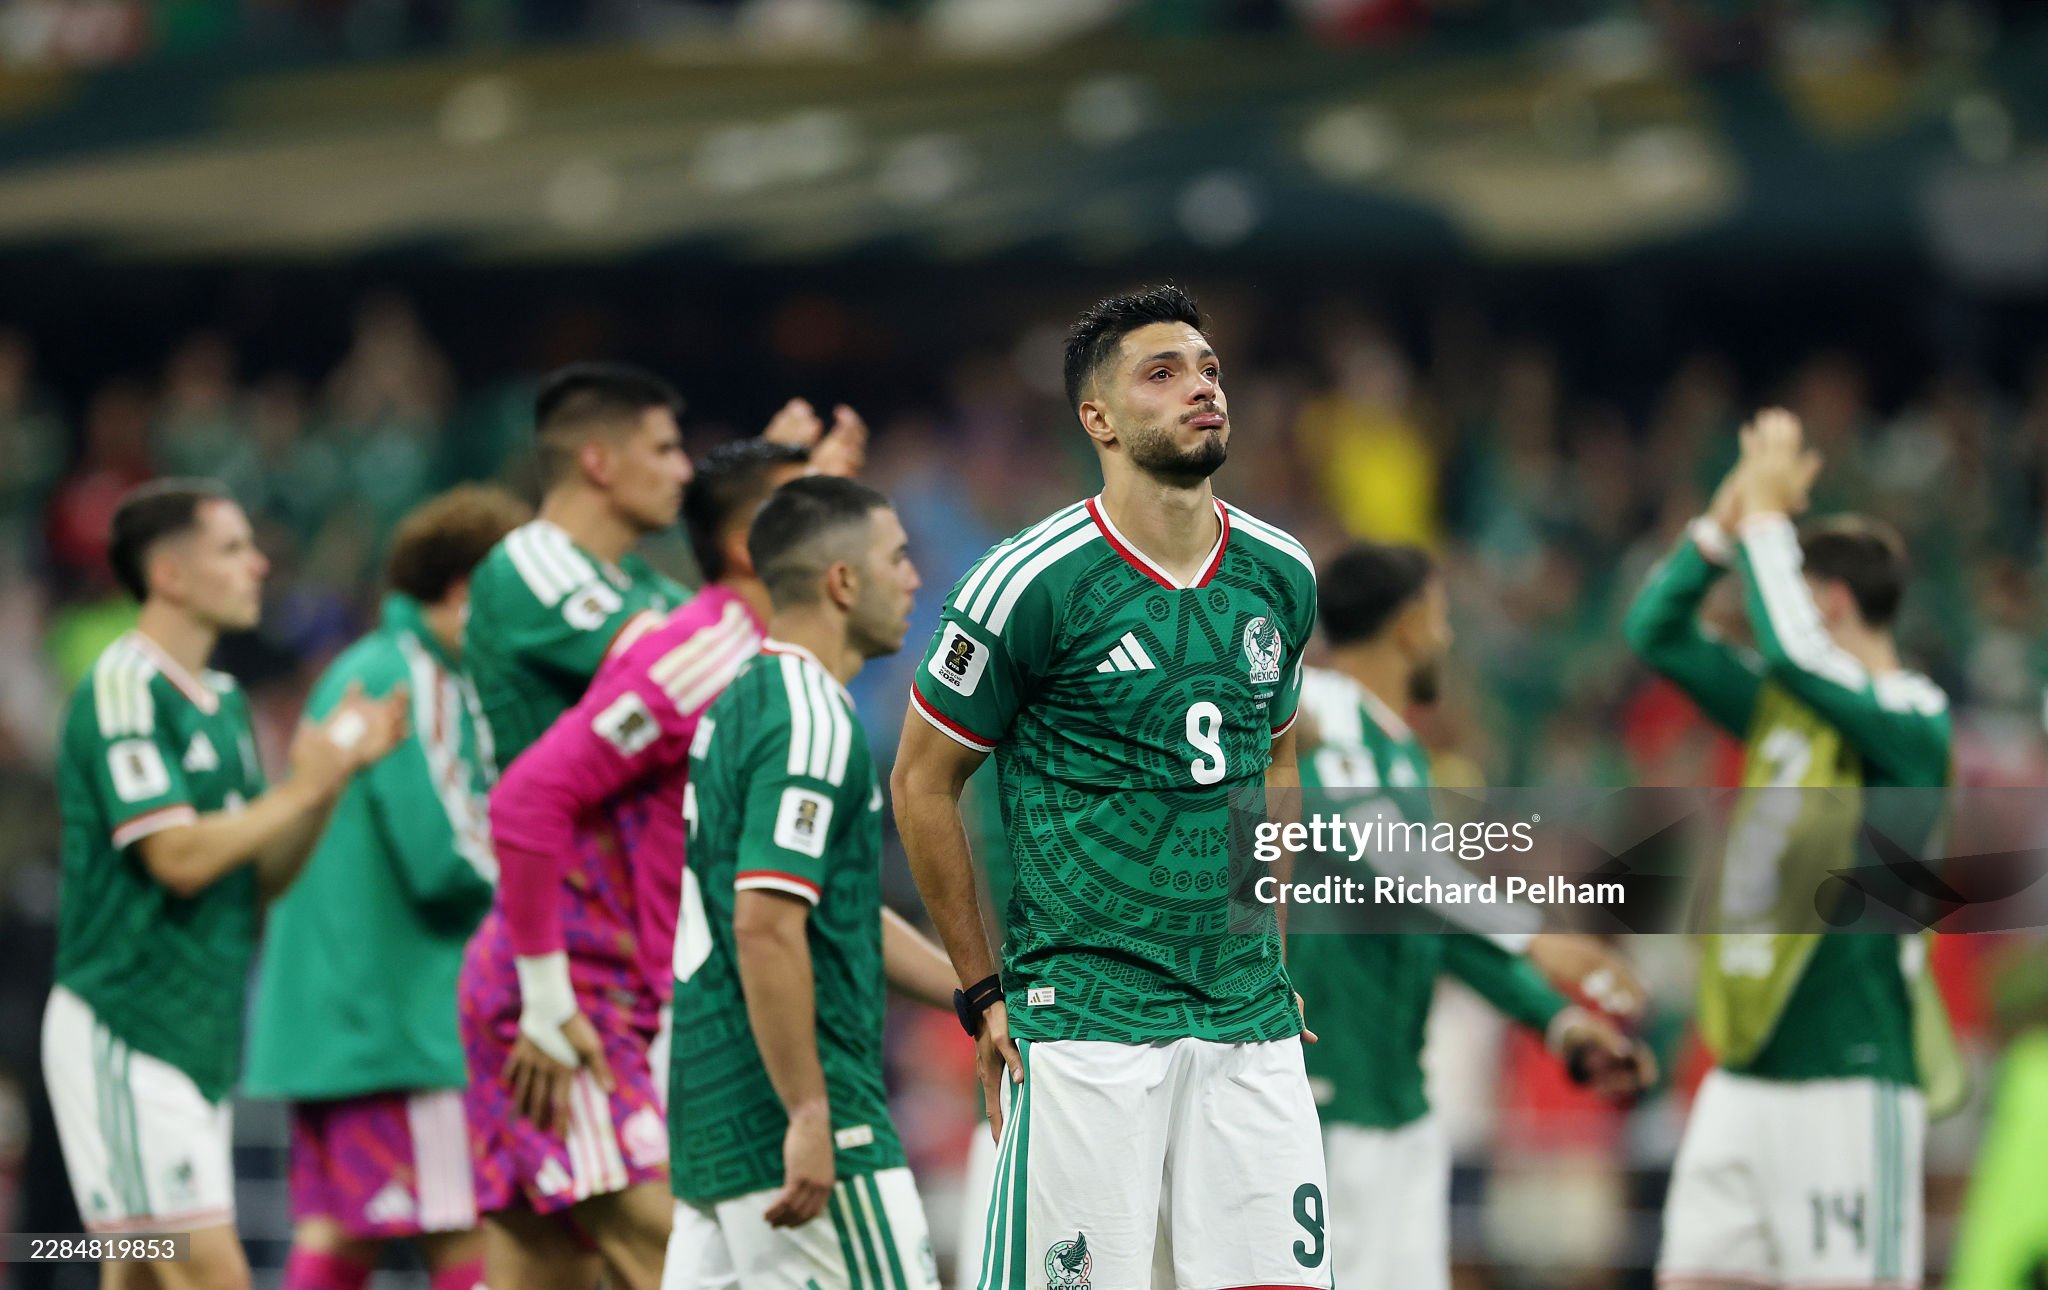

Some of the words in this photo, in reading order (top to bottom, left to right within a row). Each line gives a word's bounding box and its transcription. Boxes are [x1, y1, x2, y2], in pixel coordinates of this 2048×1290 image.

[938, 668, 961, 687] 2026
[948, 661, 960, 671] FIFA
[1250, 669, 1279, 682] MÉXICO
[1185, 701, 1226, 785] 9
[1292, 1182, 1325, 1269] 9
[1807, 1190, 1866, 1254] 14
